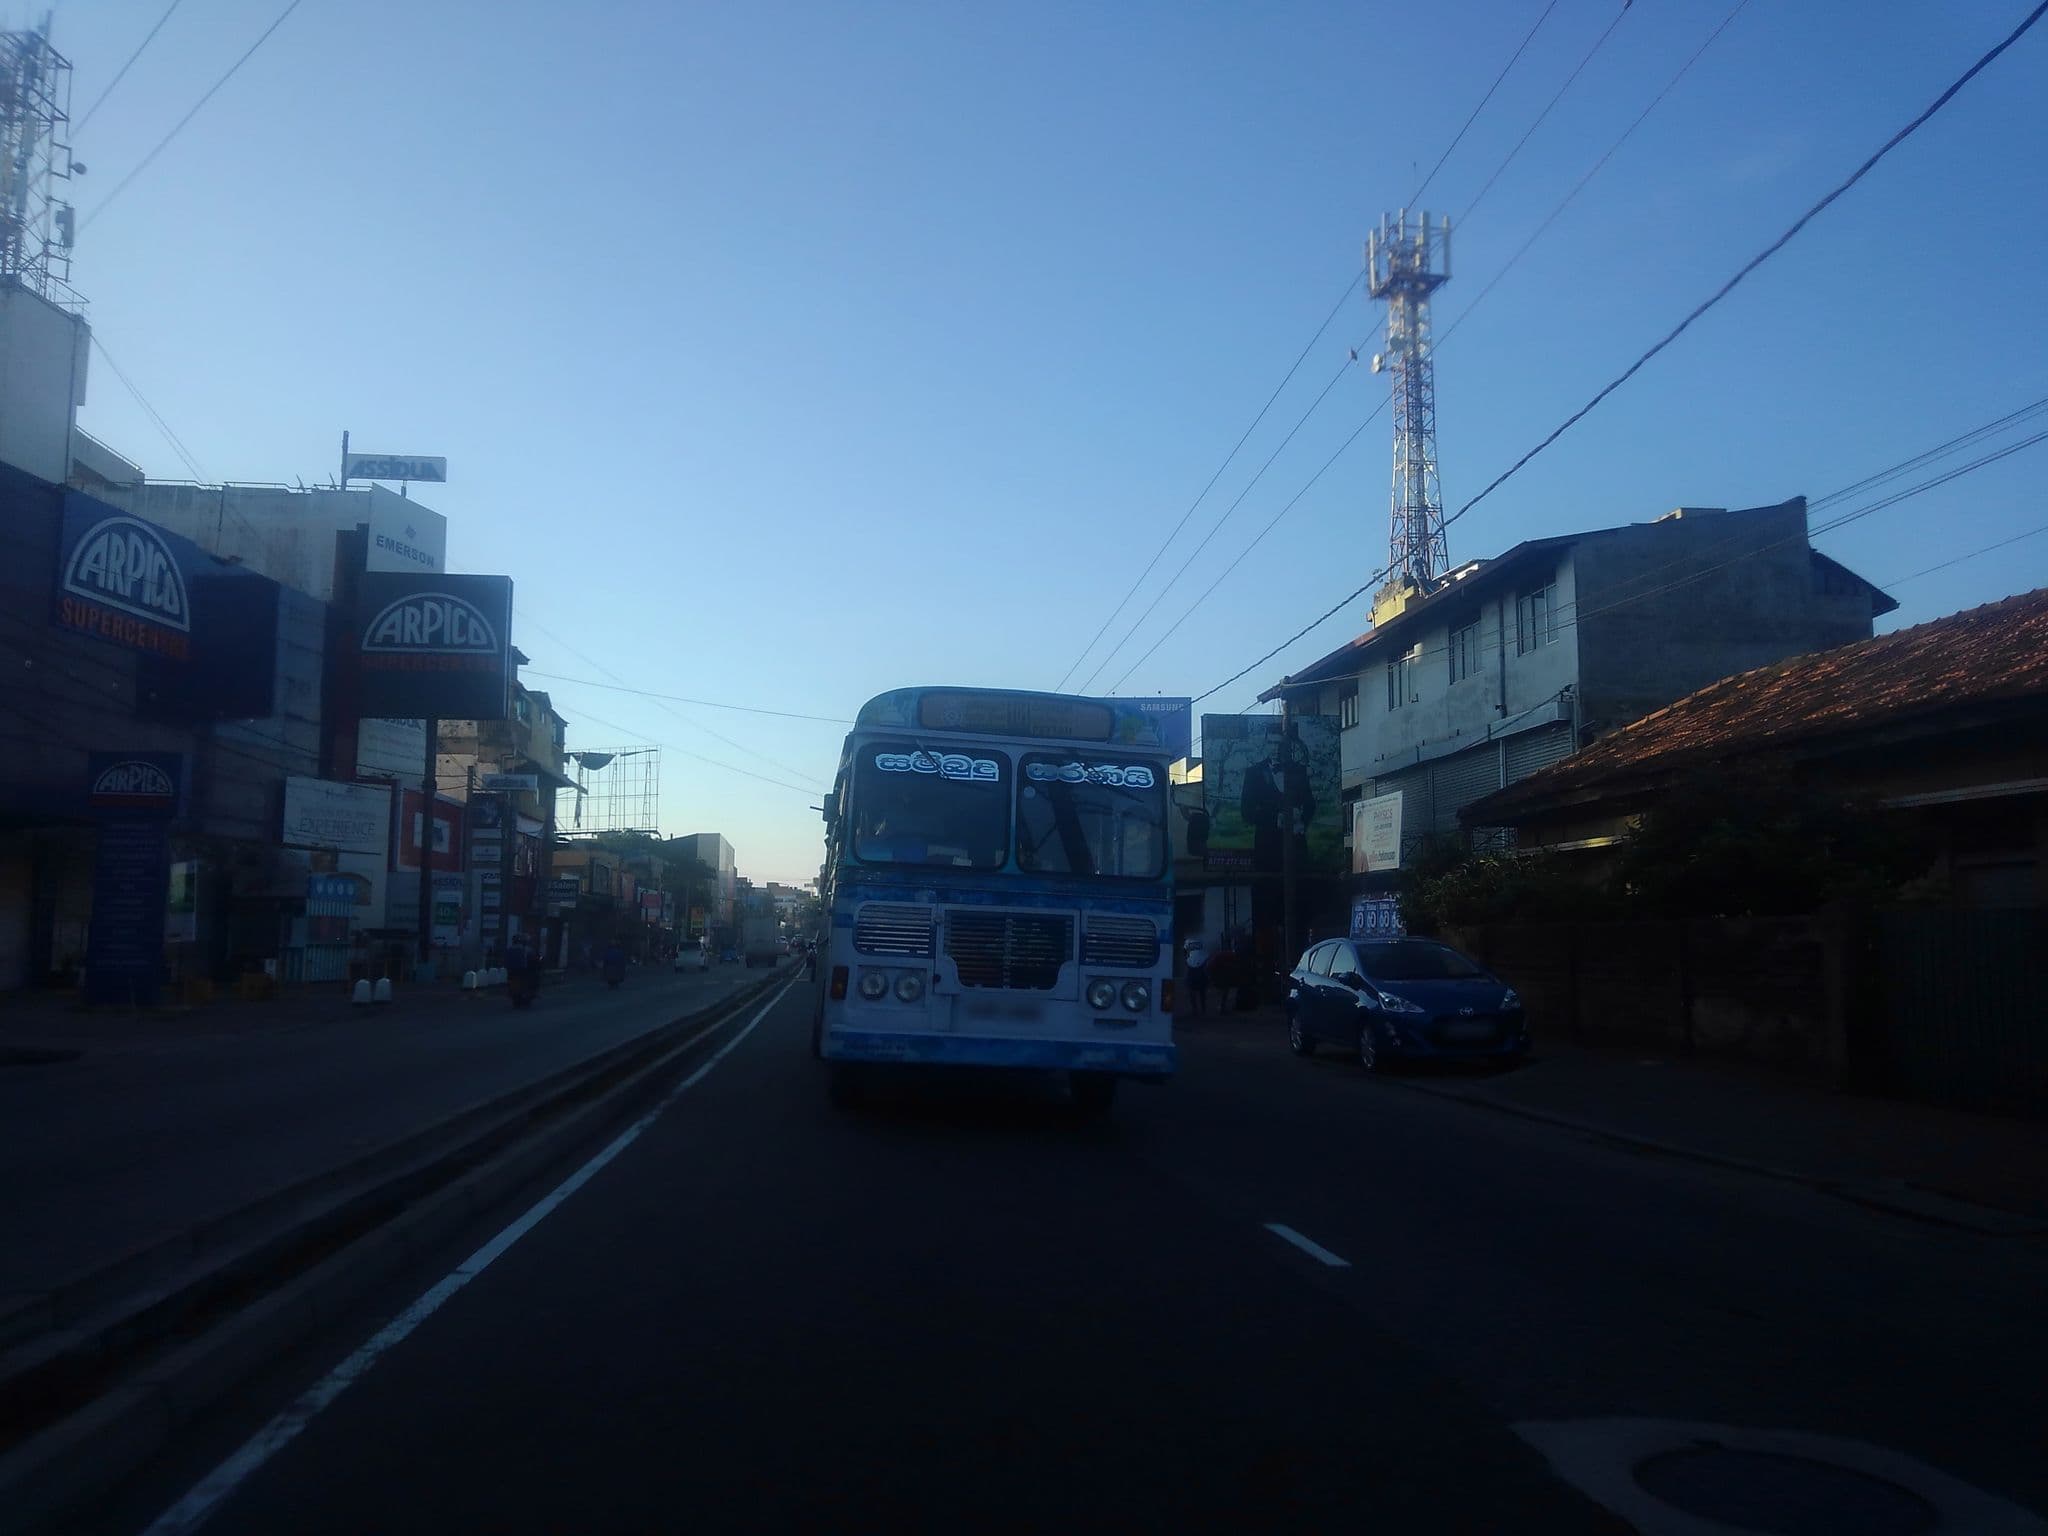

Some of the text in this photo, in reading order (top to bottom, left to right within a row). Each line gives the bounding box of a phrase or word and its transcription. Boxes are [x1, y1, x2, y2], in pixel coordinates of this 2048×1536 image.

[77, 531, 181, 615] ARPICO
[376, 535, 435, 568] EMERSON
[62, 596, 190, 661] SUPERCET
[374, 600, 488, 645] ARPICO
[100, 764, 169, 793] ARPICO
